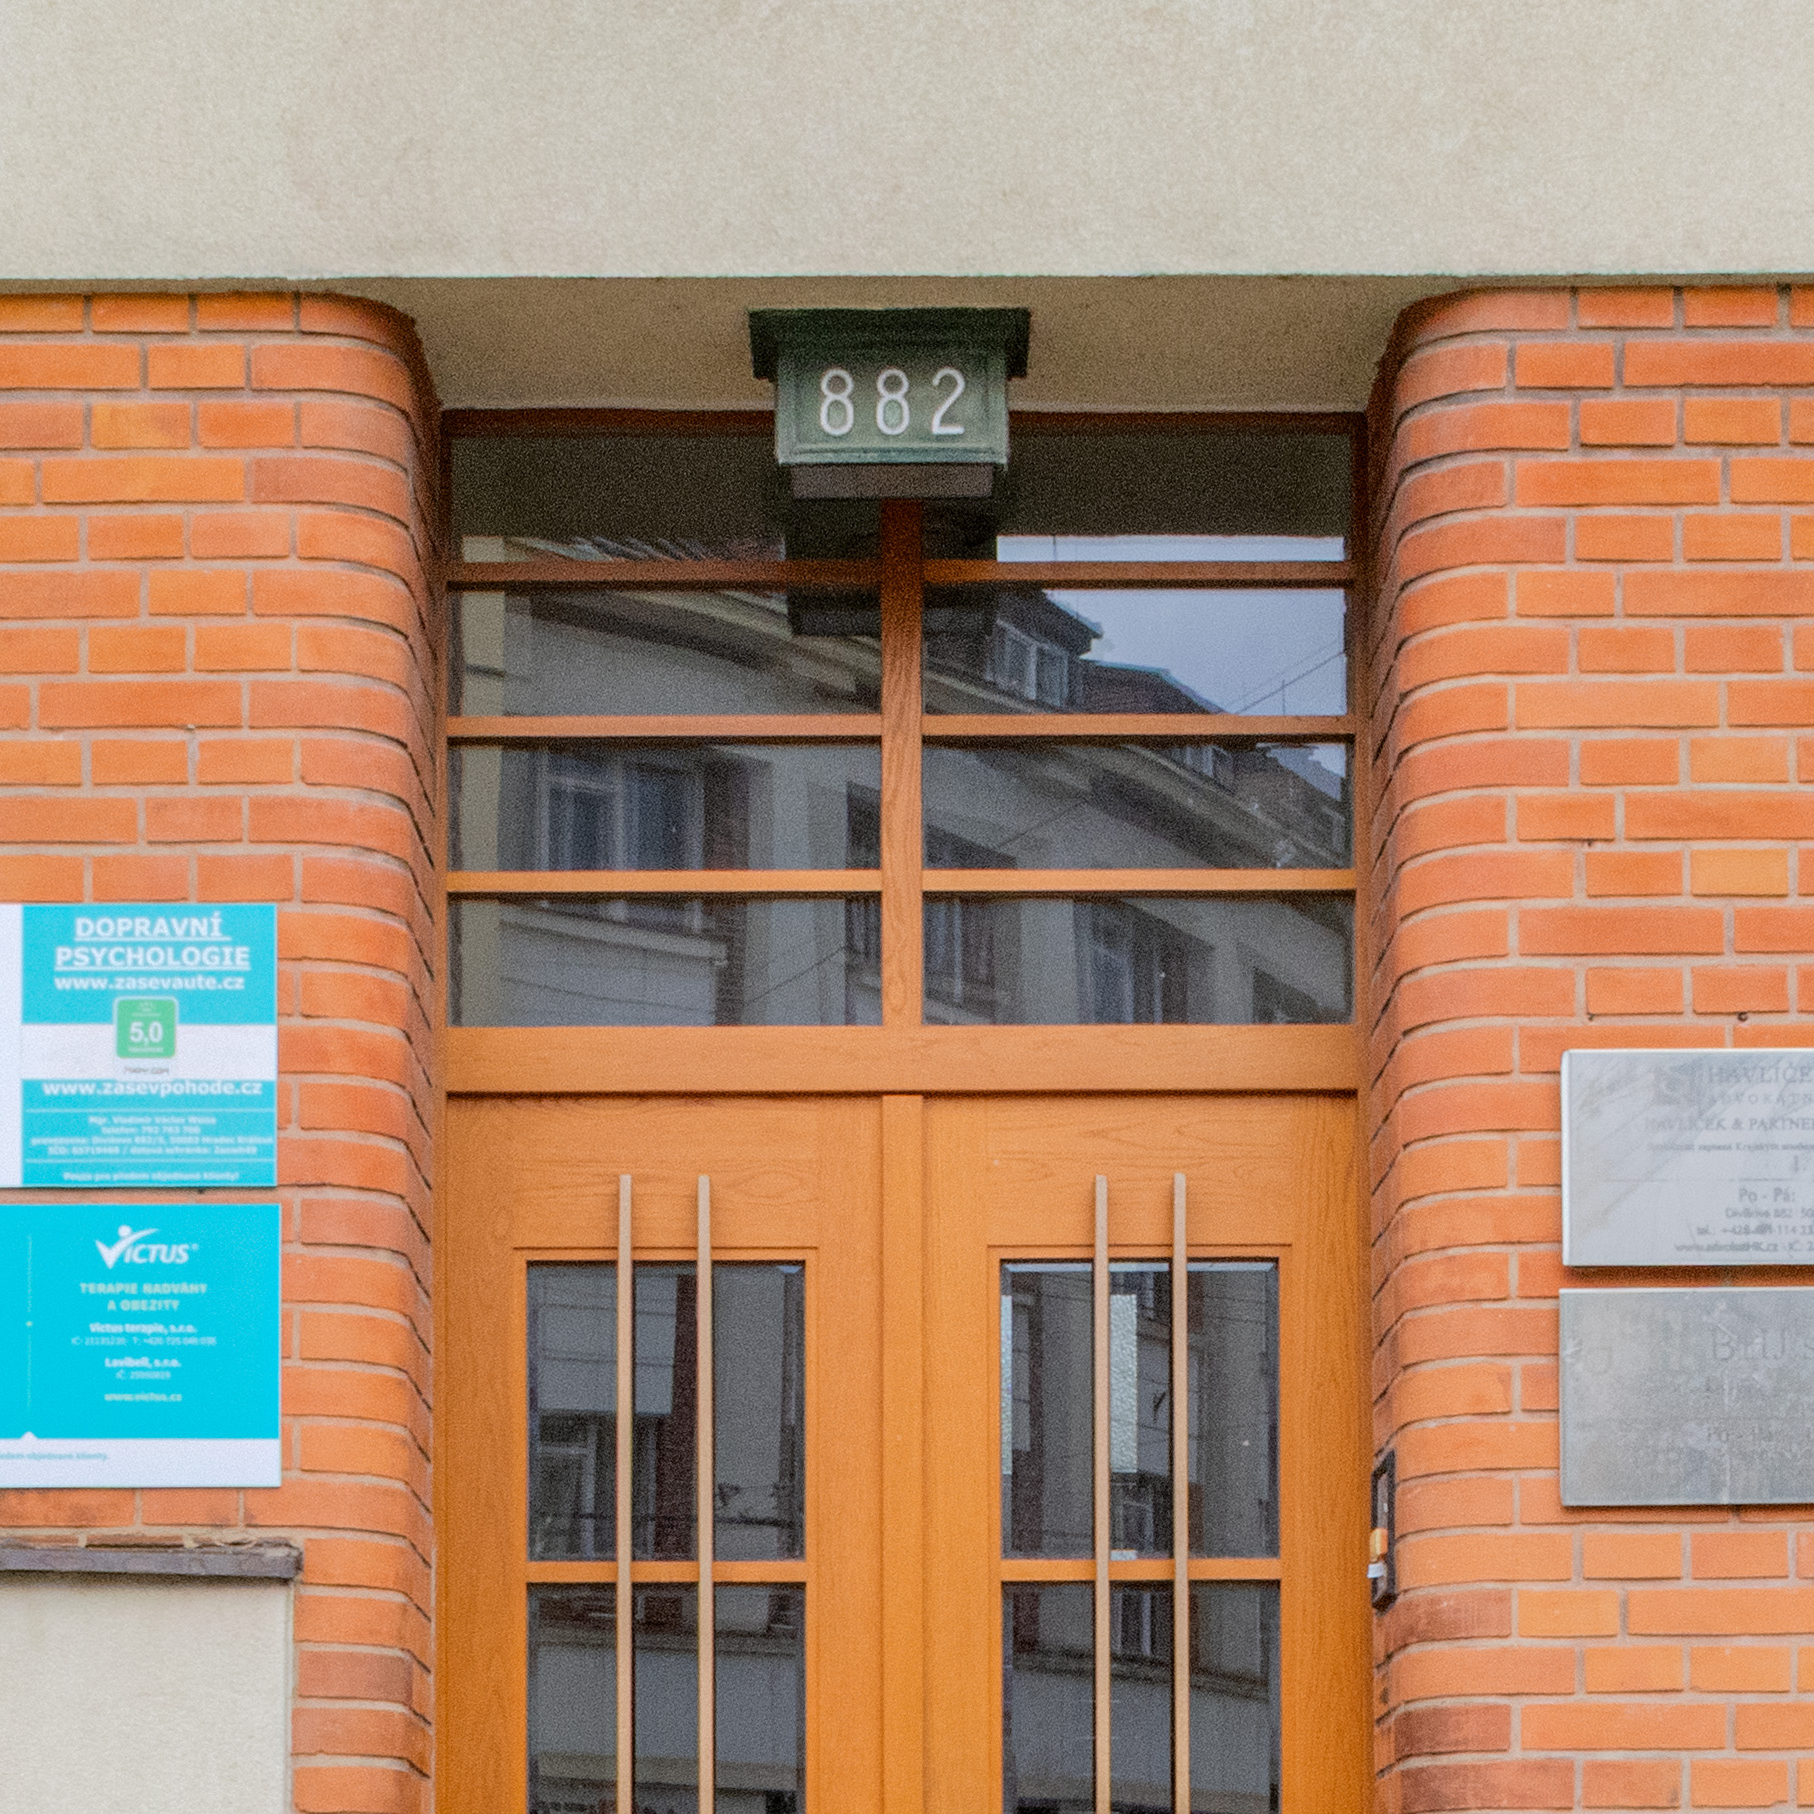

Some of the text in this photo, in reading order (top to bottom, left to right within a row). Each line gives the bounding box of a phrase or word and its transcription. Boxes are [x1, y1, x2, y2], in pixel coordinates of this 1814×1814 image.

[819, 367, 965, 436] 882
[75, 911, 223, 937] DOPRAVNÍ
[55, 946, 250, 969] PSYCHOLOGIE
[54, 973, 245, 991] www.zasevaute.cz
[129, 1021, 163, 1047] 5,0
[43, 1080, 262, 1098] www.zasevpohode.cz
[1738, 1187, 1758, 1203] Po
[79, 1281, 208, 1295] TERAPIE NADVÁHY
[107, 1299, 180, 1311] A OBEZITY
